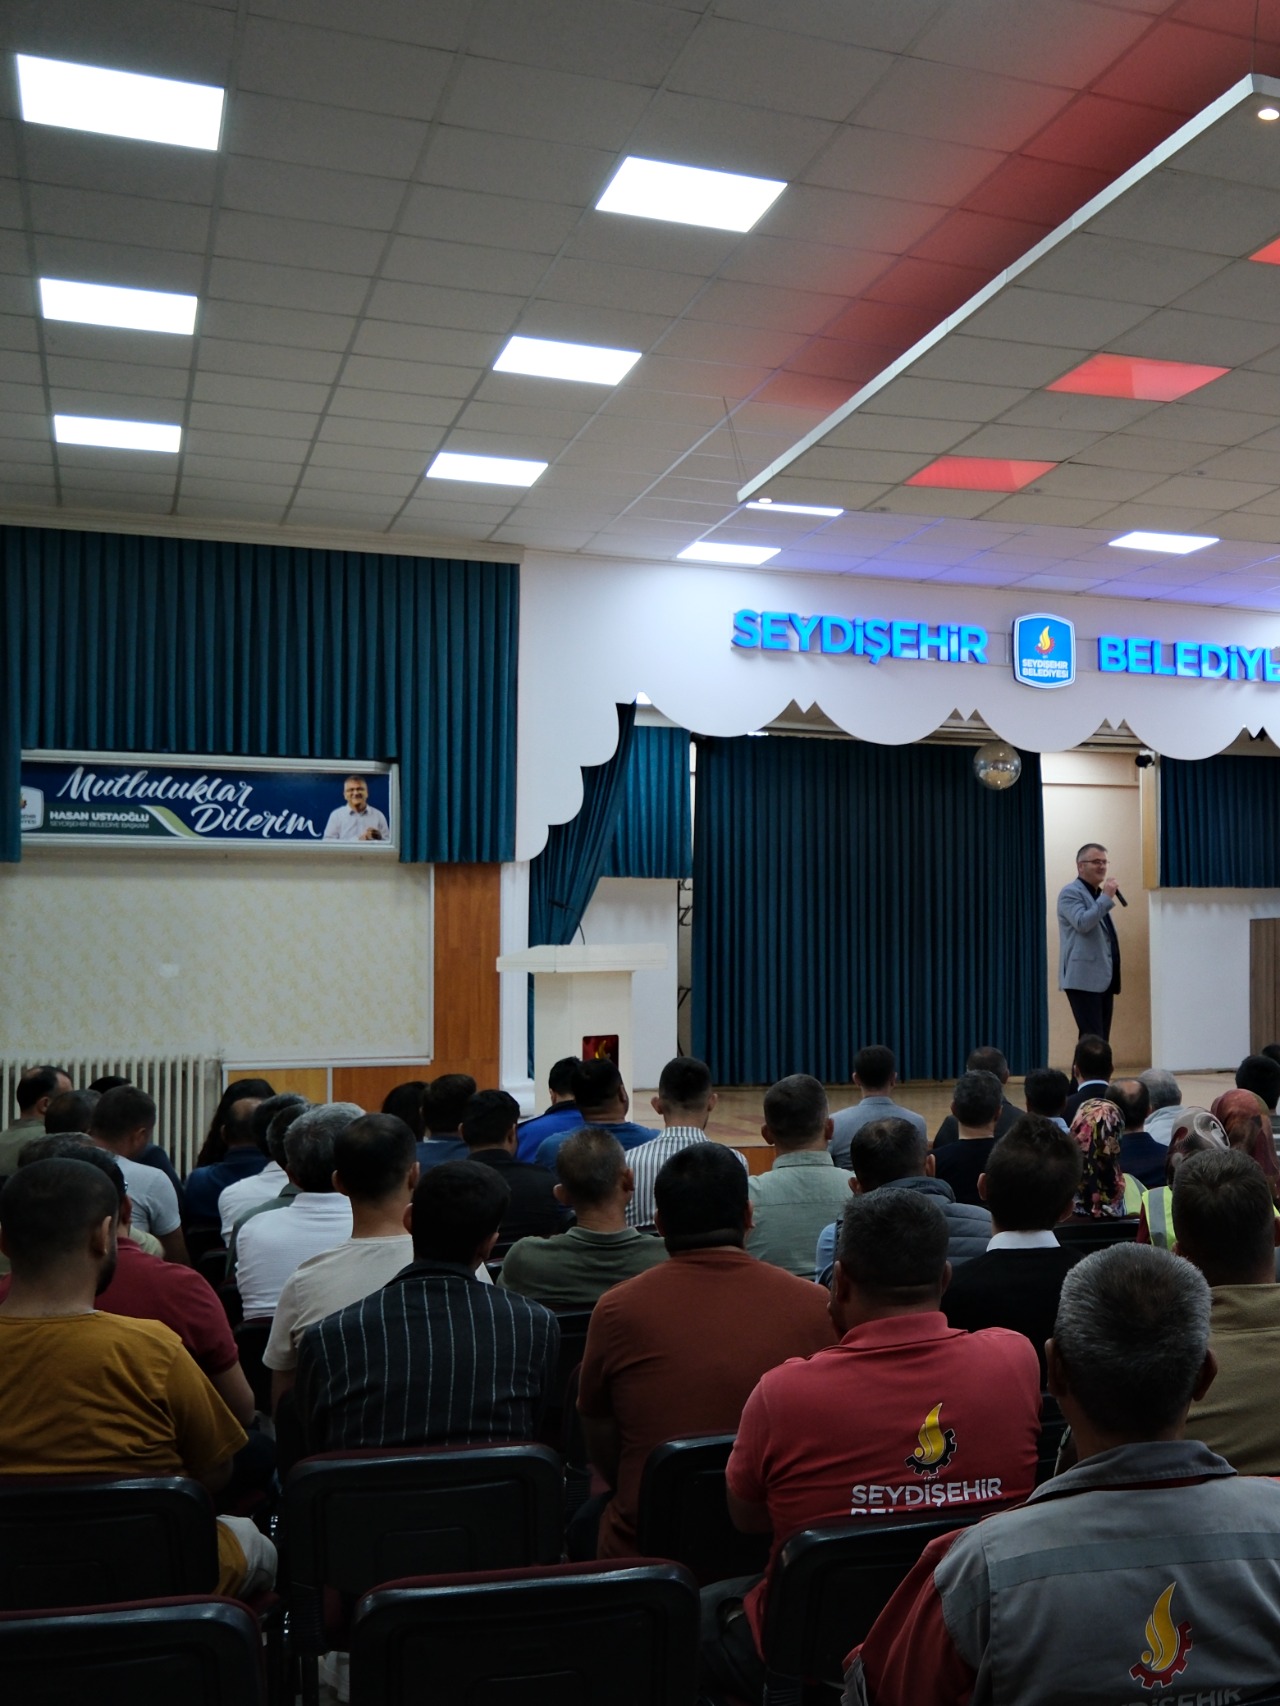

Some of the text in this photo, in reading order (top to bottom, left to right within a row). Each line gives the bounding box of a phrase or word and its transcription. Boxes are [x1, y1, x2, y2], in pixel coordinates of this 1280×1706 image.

[57, 766, 253, 806] Mutluluklar
[49, 811, 90, 820] HASAN
[91, 811, 150, 823] USTAOĞLU
[190, 803, 322, 838] Dilerim
[851, 1477, 1003, 1507] SEYDİŞEHİR
